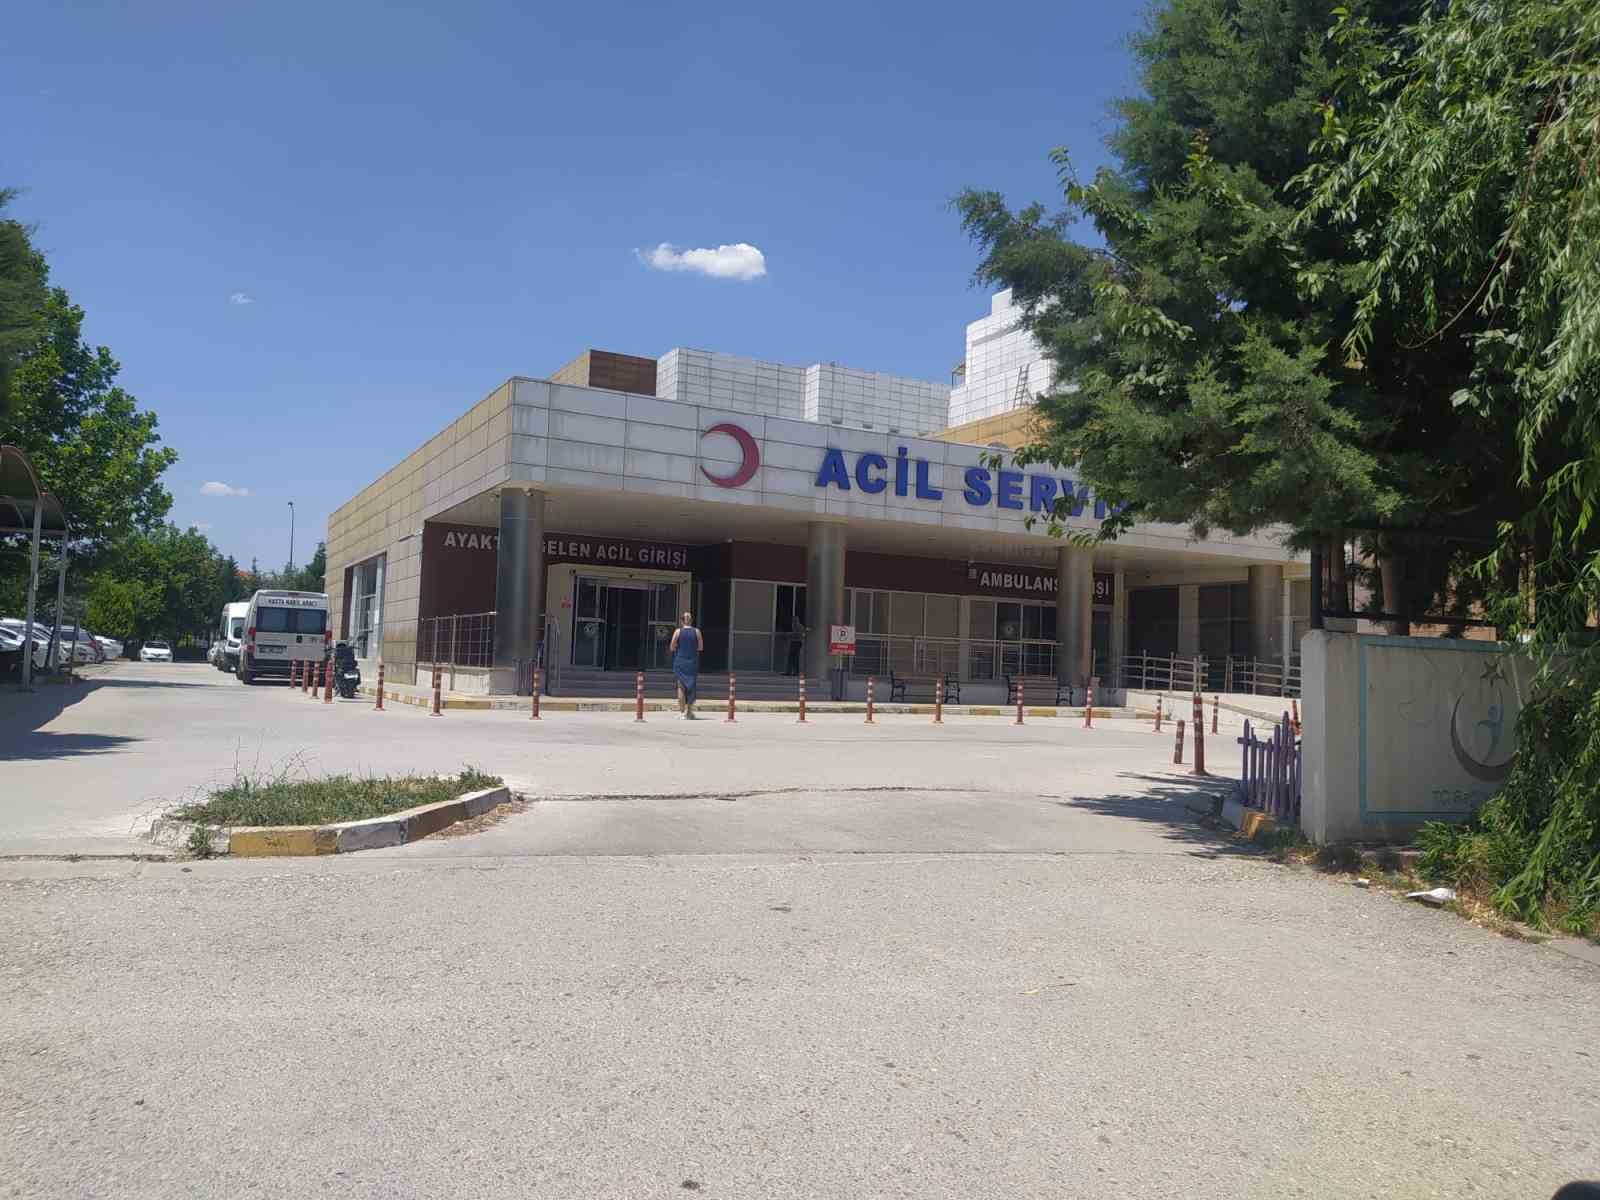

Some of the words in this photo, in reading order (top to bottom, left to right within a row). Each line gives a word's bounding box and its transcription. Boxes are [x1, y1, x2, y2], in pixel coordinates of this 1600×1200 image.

[814, 446, 943, 500] ACİL
[542, 540, 590, 558] ELEN
[596, 543, 633, 561] ACİL
[639, 545, 687, 568] GİRİŞİ
